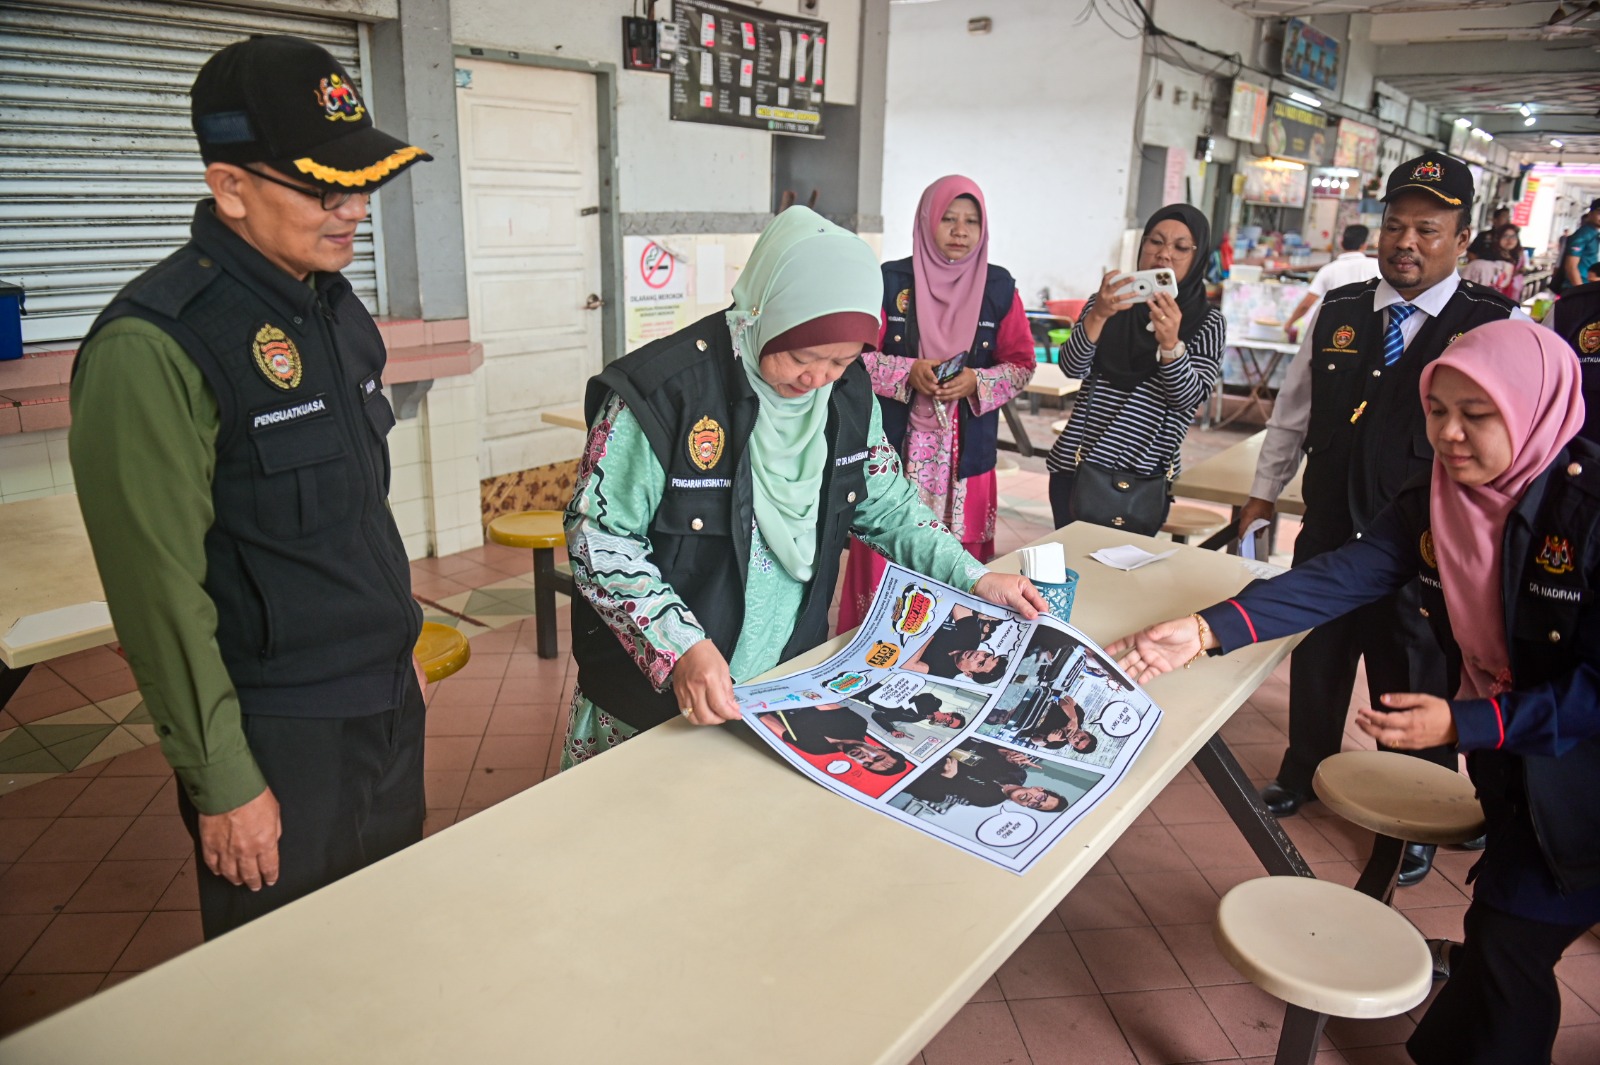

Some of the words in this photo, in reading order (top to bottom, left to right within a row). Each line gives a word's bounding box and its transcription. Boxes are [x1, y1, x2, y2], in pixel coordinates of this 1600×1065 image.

[254, 399, 326, 428] PENGUATKUASA
[672, 478, 702, 488] PENGARAH
[702, 479, 732, 487] KESIHATAN
[1541, 586, 1581, 602] NADIRAH
[868, 646, 889, 664] OUT
[878, 648, 896, 666] SPEAK
[1012, 822, 1021, 830] ADA
